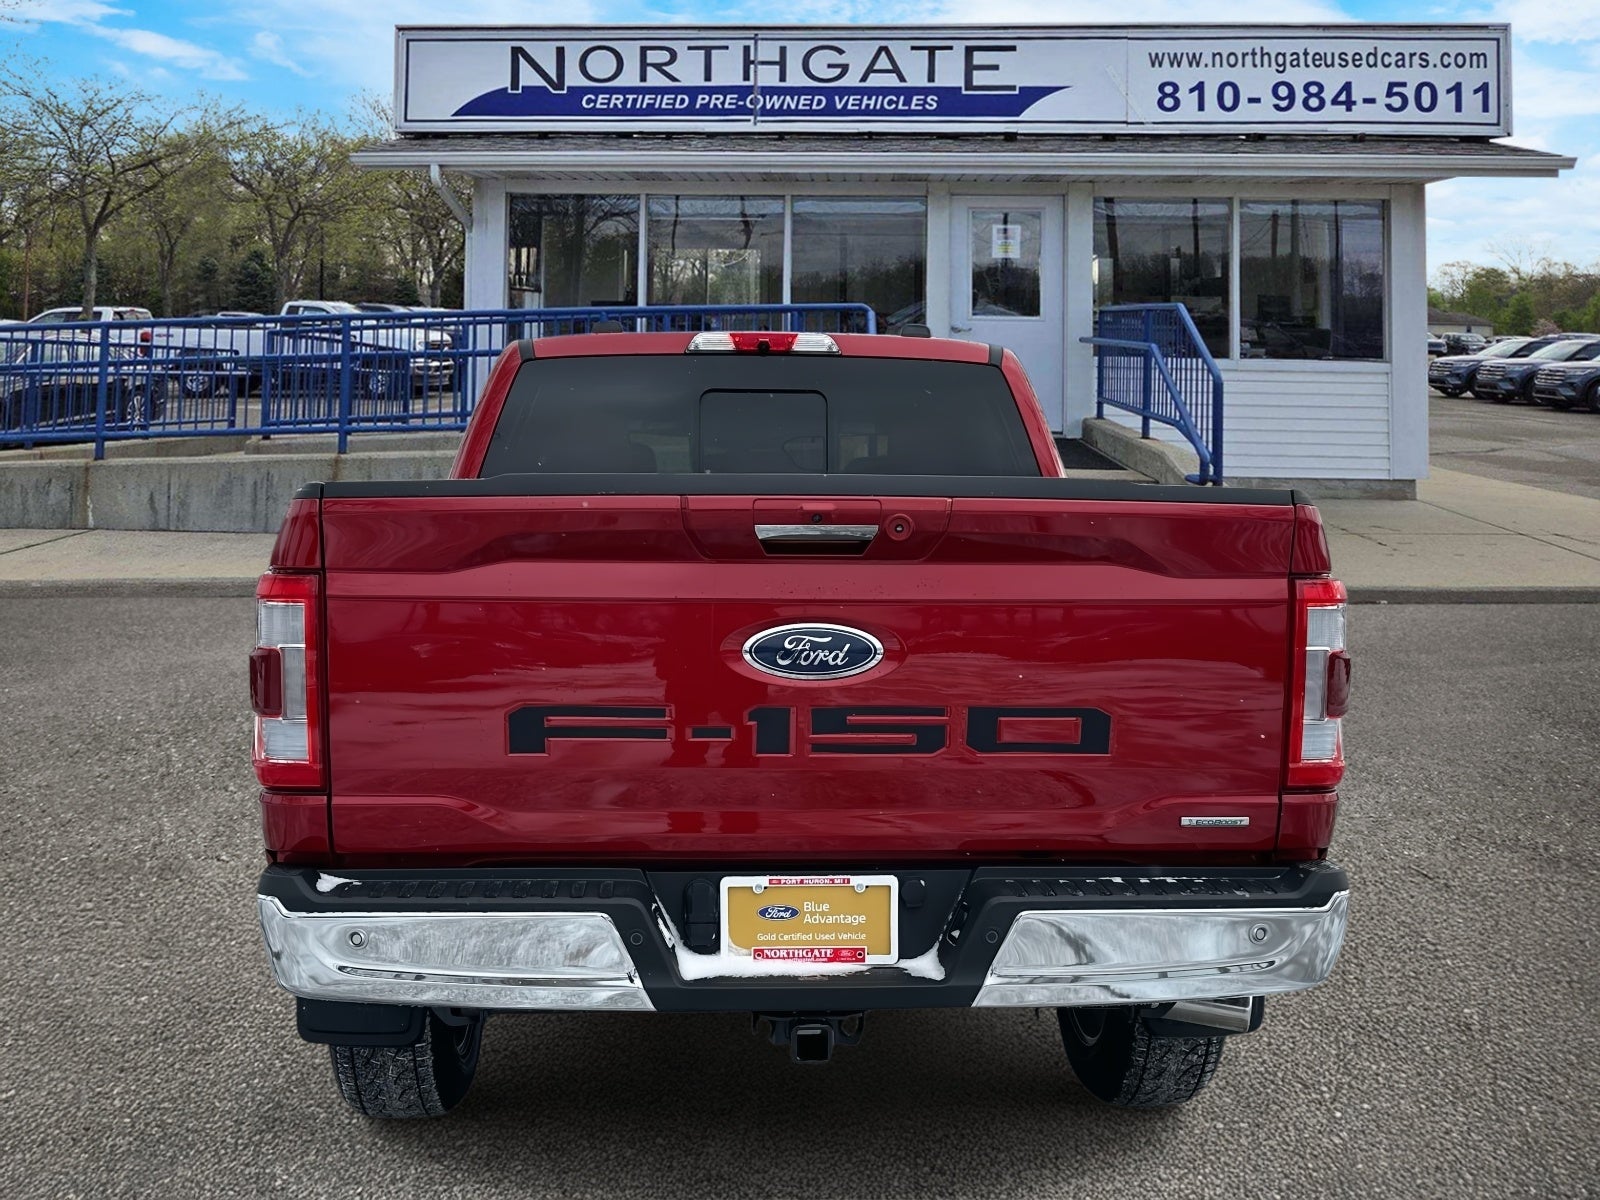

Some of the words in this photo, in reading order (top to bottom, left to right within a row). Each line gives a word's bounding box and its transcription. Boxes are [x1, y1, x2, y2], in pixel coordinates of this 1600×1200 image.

[1148, 46, 1488, 74] www.northgateusedcars.com
[510, 45, 1017, 92] NORTHGATE
[581, 94, 689, 109] CERTIFIED
[695, 94, 827, 110] PRE-OWNED
[834, 94, 939, 110] VEHICLES
[1157, 81, 1490, 113] 810-984-5011
[776, 635, 851, 666] Ford
[506, 704, 1113, 756] F-150
[1195, 818, 1245, 826] ECOBOOST
[765, 906, 792, 918] Ford
[803, 901, 830, 912] Blue
[803, 913, 866, 925] Advantage
[757, 932, 776, 941] Gold
[778, 932, 813, 941] Certified
[814, 932, 836, 940] Used
[837, 931, 867, 940] Vehicle
[763, 949, 834, 958] NORTHGATE
